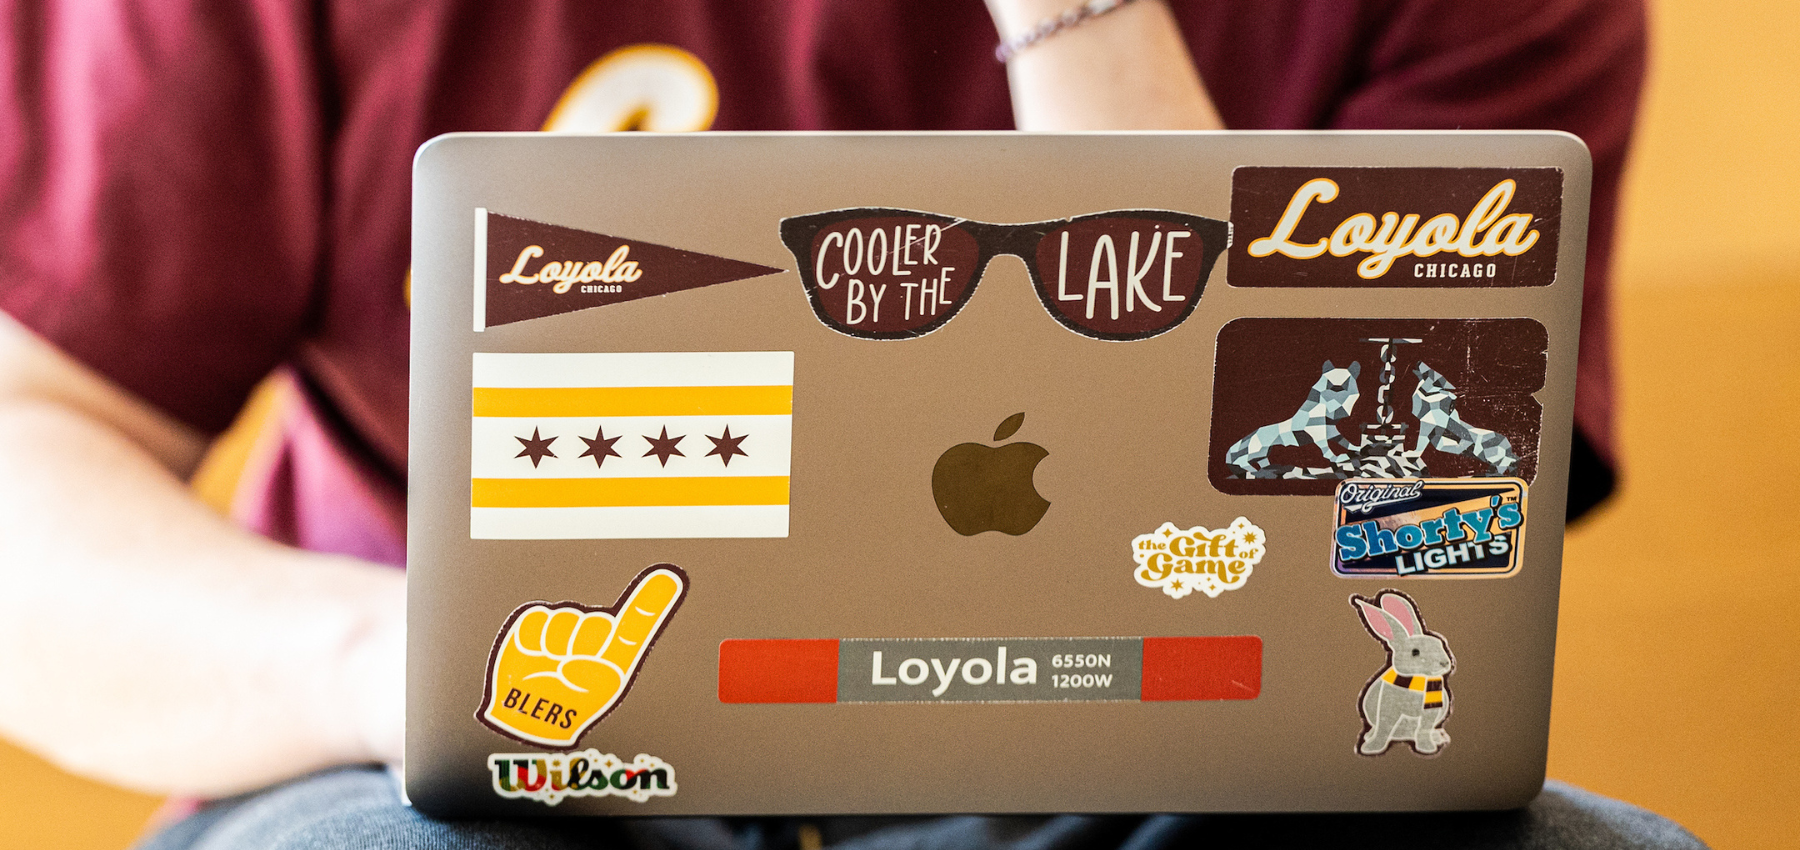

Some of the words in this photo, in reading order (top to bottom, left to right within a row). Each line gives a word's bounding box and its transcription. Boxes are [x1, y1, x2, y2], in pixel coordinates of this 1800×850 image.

[1247, 178, 1540, 279] Loyola
[499, 245, 643, 294] Loyola
[816, 224, 942, 290] COOLER
[1058, 231, 1191, 320] LAKE
[1414, 263, 1496, 278] CHICAGO
[580, 285, 622, 293] CHICAGO
[846, 279, 886, 324] BY
[901, 267, 955, 321] THE
[1341, 480, 1425, 514] Original
[1138, 539, 1167, 550] the
[1169, 532, 1239, 558] Gift
[1239, 548, 1259, 559] of
[1336, 495, 1522, 561] Shorty's
[1141, 552, 1246, 584] Game
[1395, 534, 1510, 575] LIGHTS
[872, 646, 1038, 697] Loyola
[1051, 654, 1112, 668] 6550N
[1051, 674, 1113, 688] 1200W
[503, 687, 577, 729] BLERS
[494, 757, 670, 792] Wilson
